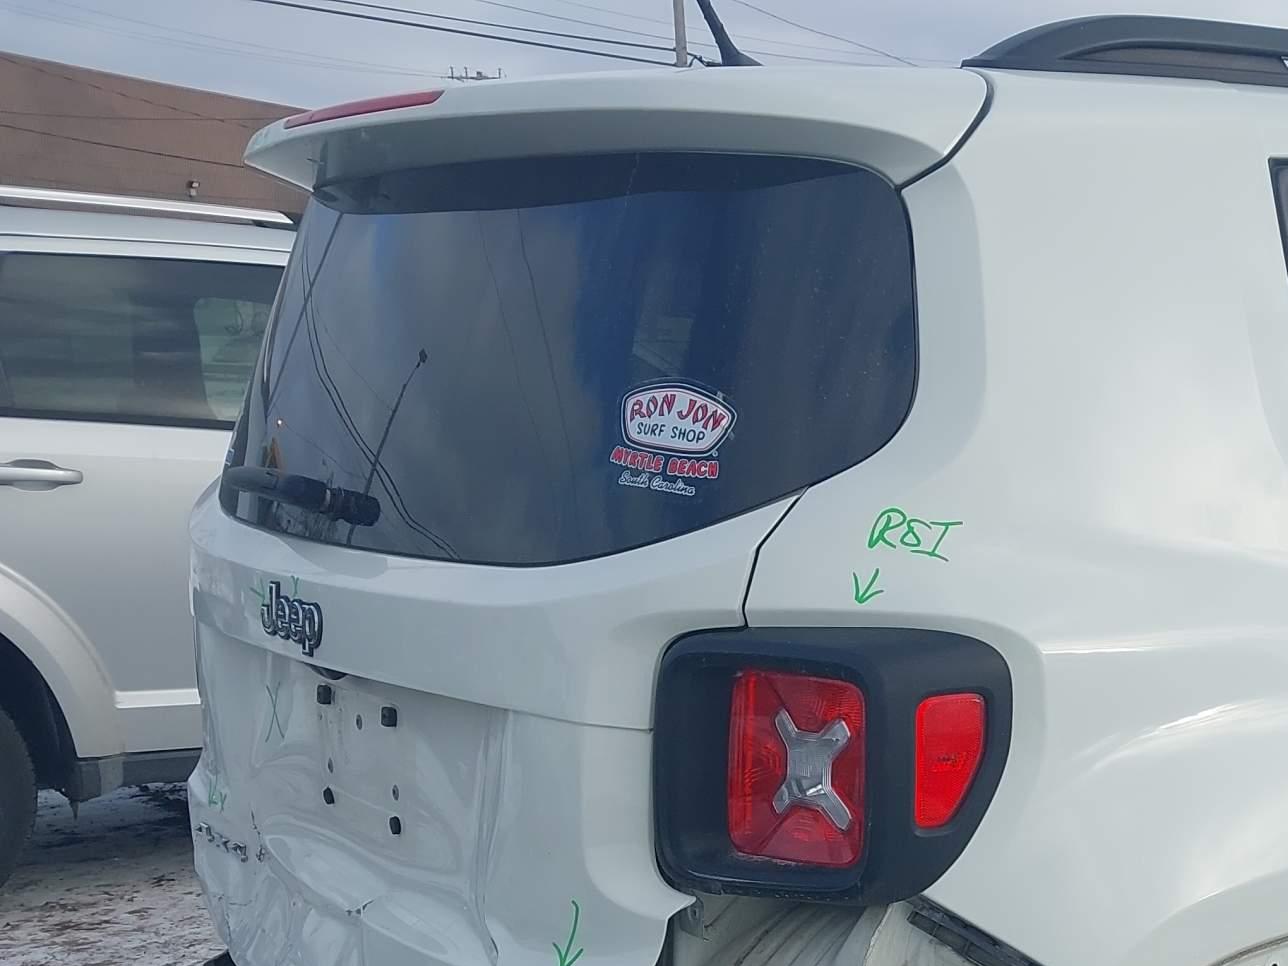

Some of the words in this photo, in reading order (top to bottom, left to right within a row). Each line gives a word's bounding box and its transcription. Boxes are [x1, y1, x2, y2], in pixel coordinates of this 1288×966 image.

[630, 393, 676, 422] RON
[677, 398, 726, 432] JON
[637, 422, 666, 437] SURF
[671, 426, 706, 443] SHOP
[610, 446, 665, 473] MYRTLE
[667, 457, 719, 479] BEACH
[619, 470, 649, 488] South
[650, 476, 695, 496] Carolina
[261, 581, 323, 657] Jeep
